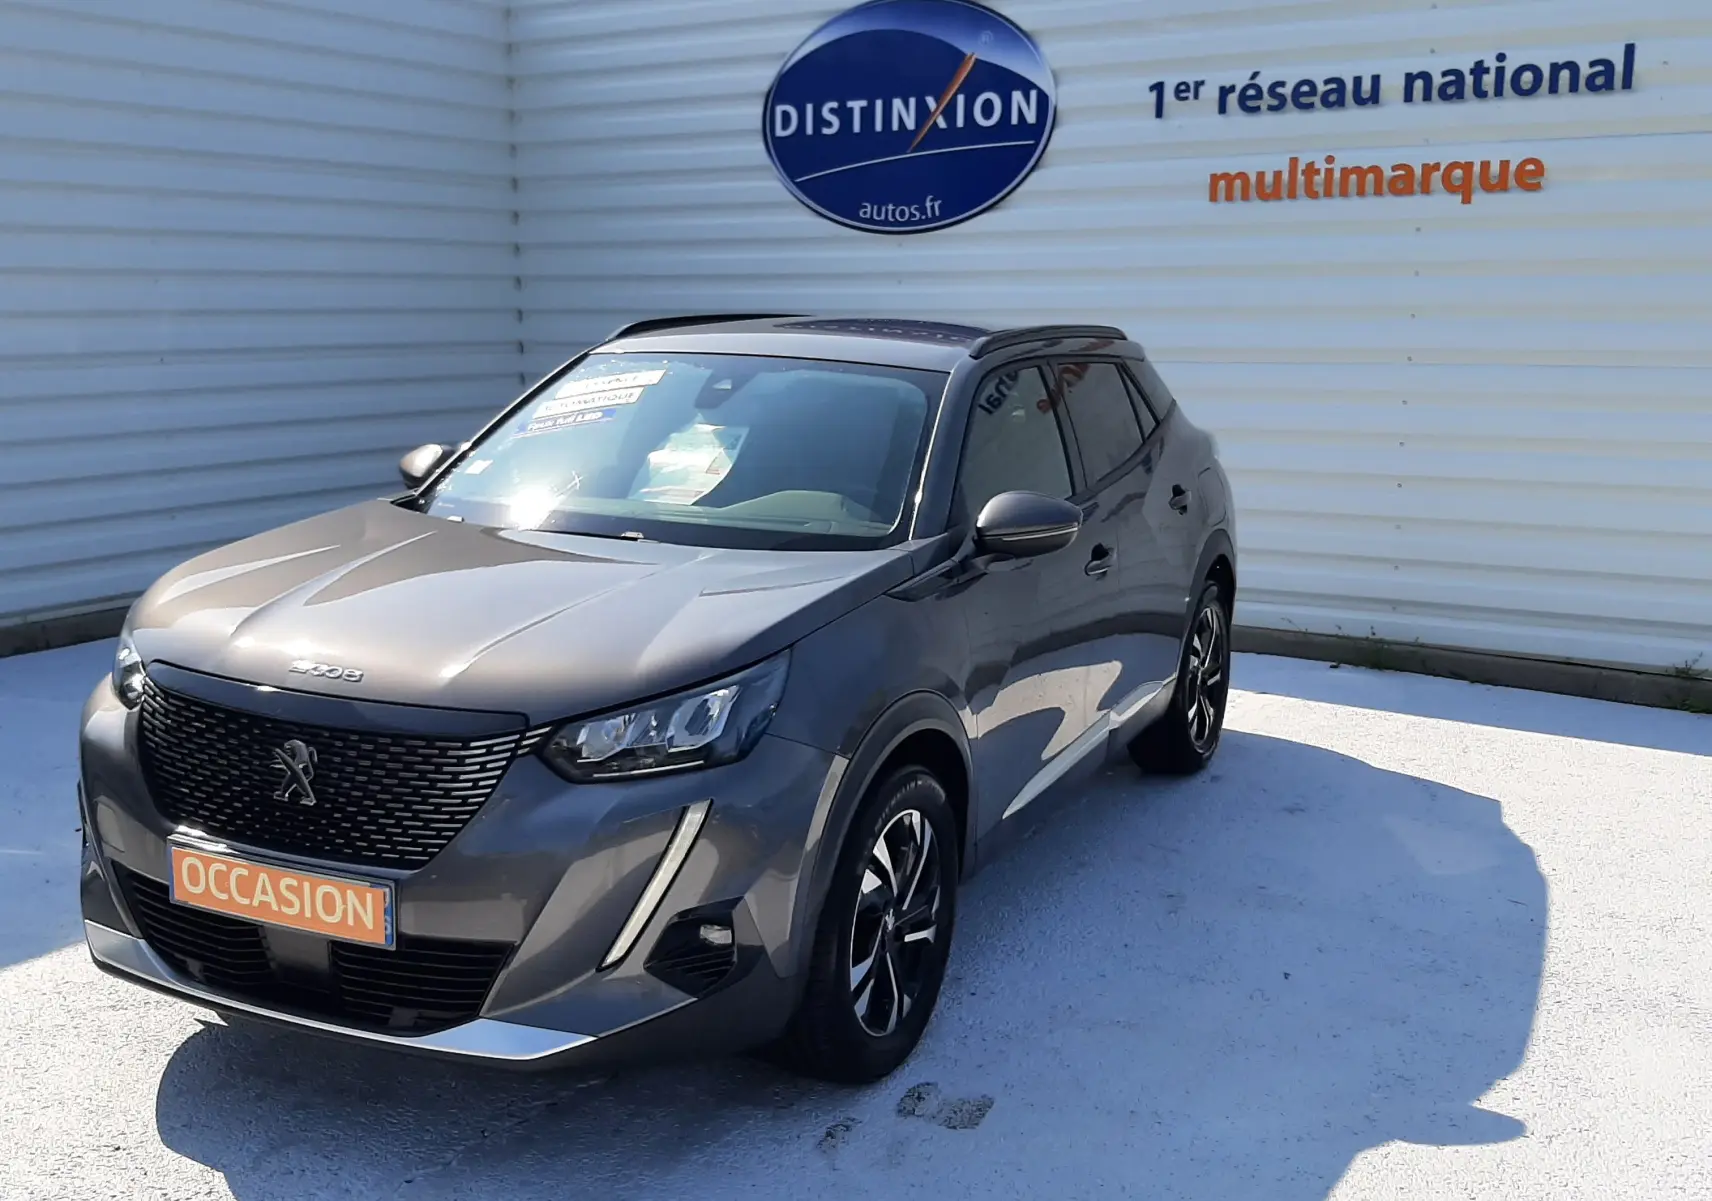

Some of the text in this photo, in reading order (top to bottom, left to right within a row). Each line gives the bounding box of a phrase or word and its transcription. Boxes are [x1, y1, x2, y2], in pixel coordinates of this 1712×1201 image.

[1149, 42, 1636, 119] 1er réseau national
[774, 88, 1038, 139] DISTINXION
[1208, 155, 1545, 204] multimarque
[858, 195, 943, 222] autos.fr
[180, 856, 375, 931] OCCASION
